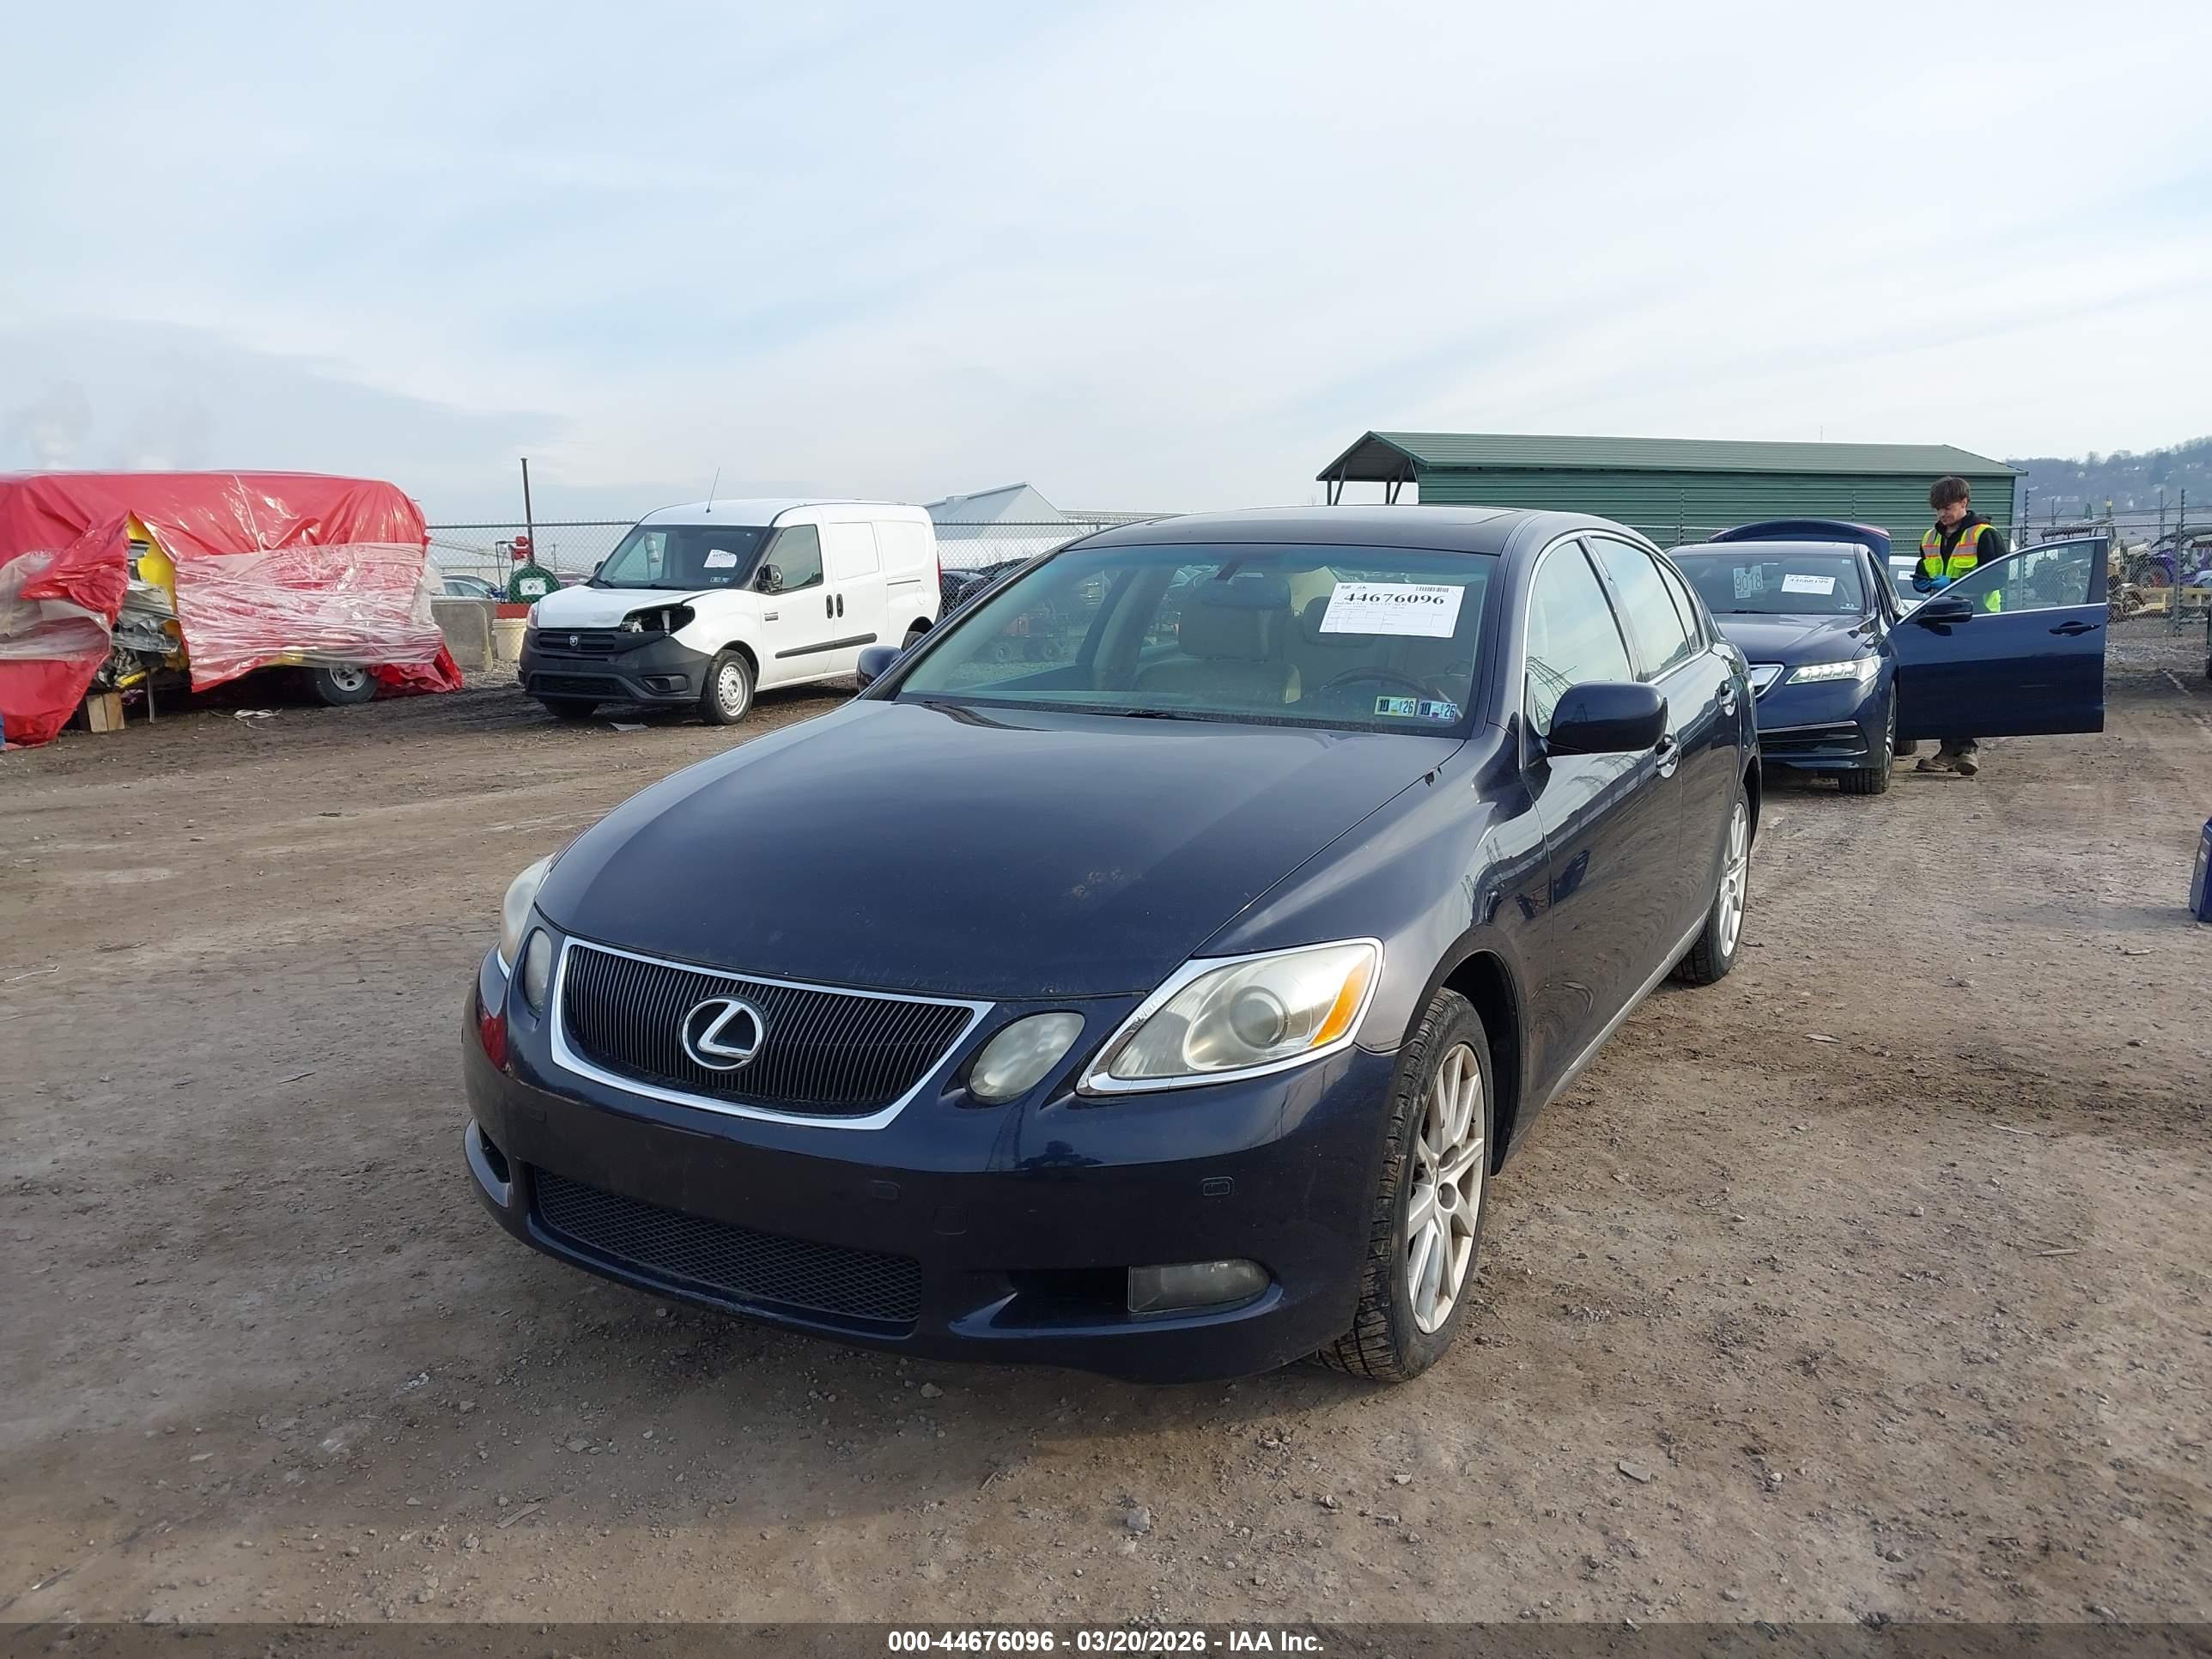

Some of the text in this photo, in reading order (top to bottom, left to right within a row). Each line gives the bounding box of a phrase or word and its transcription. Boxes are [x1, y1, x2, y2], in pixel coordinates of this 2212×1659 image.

[1344, 592, 1445, 605] 44676096
[1403, 701, 1414, 714] 26
[1444, 704, 1456, 718] 26
